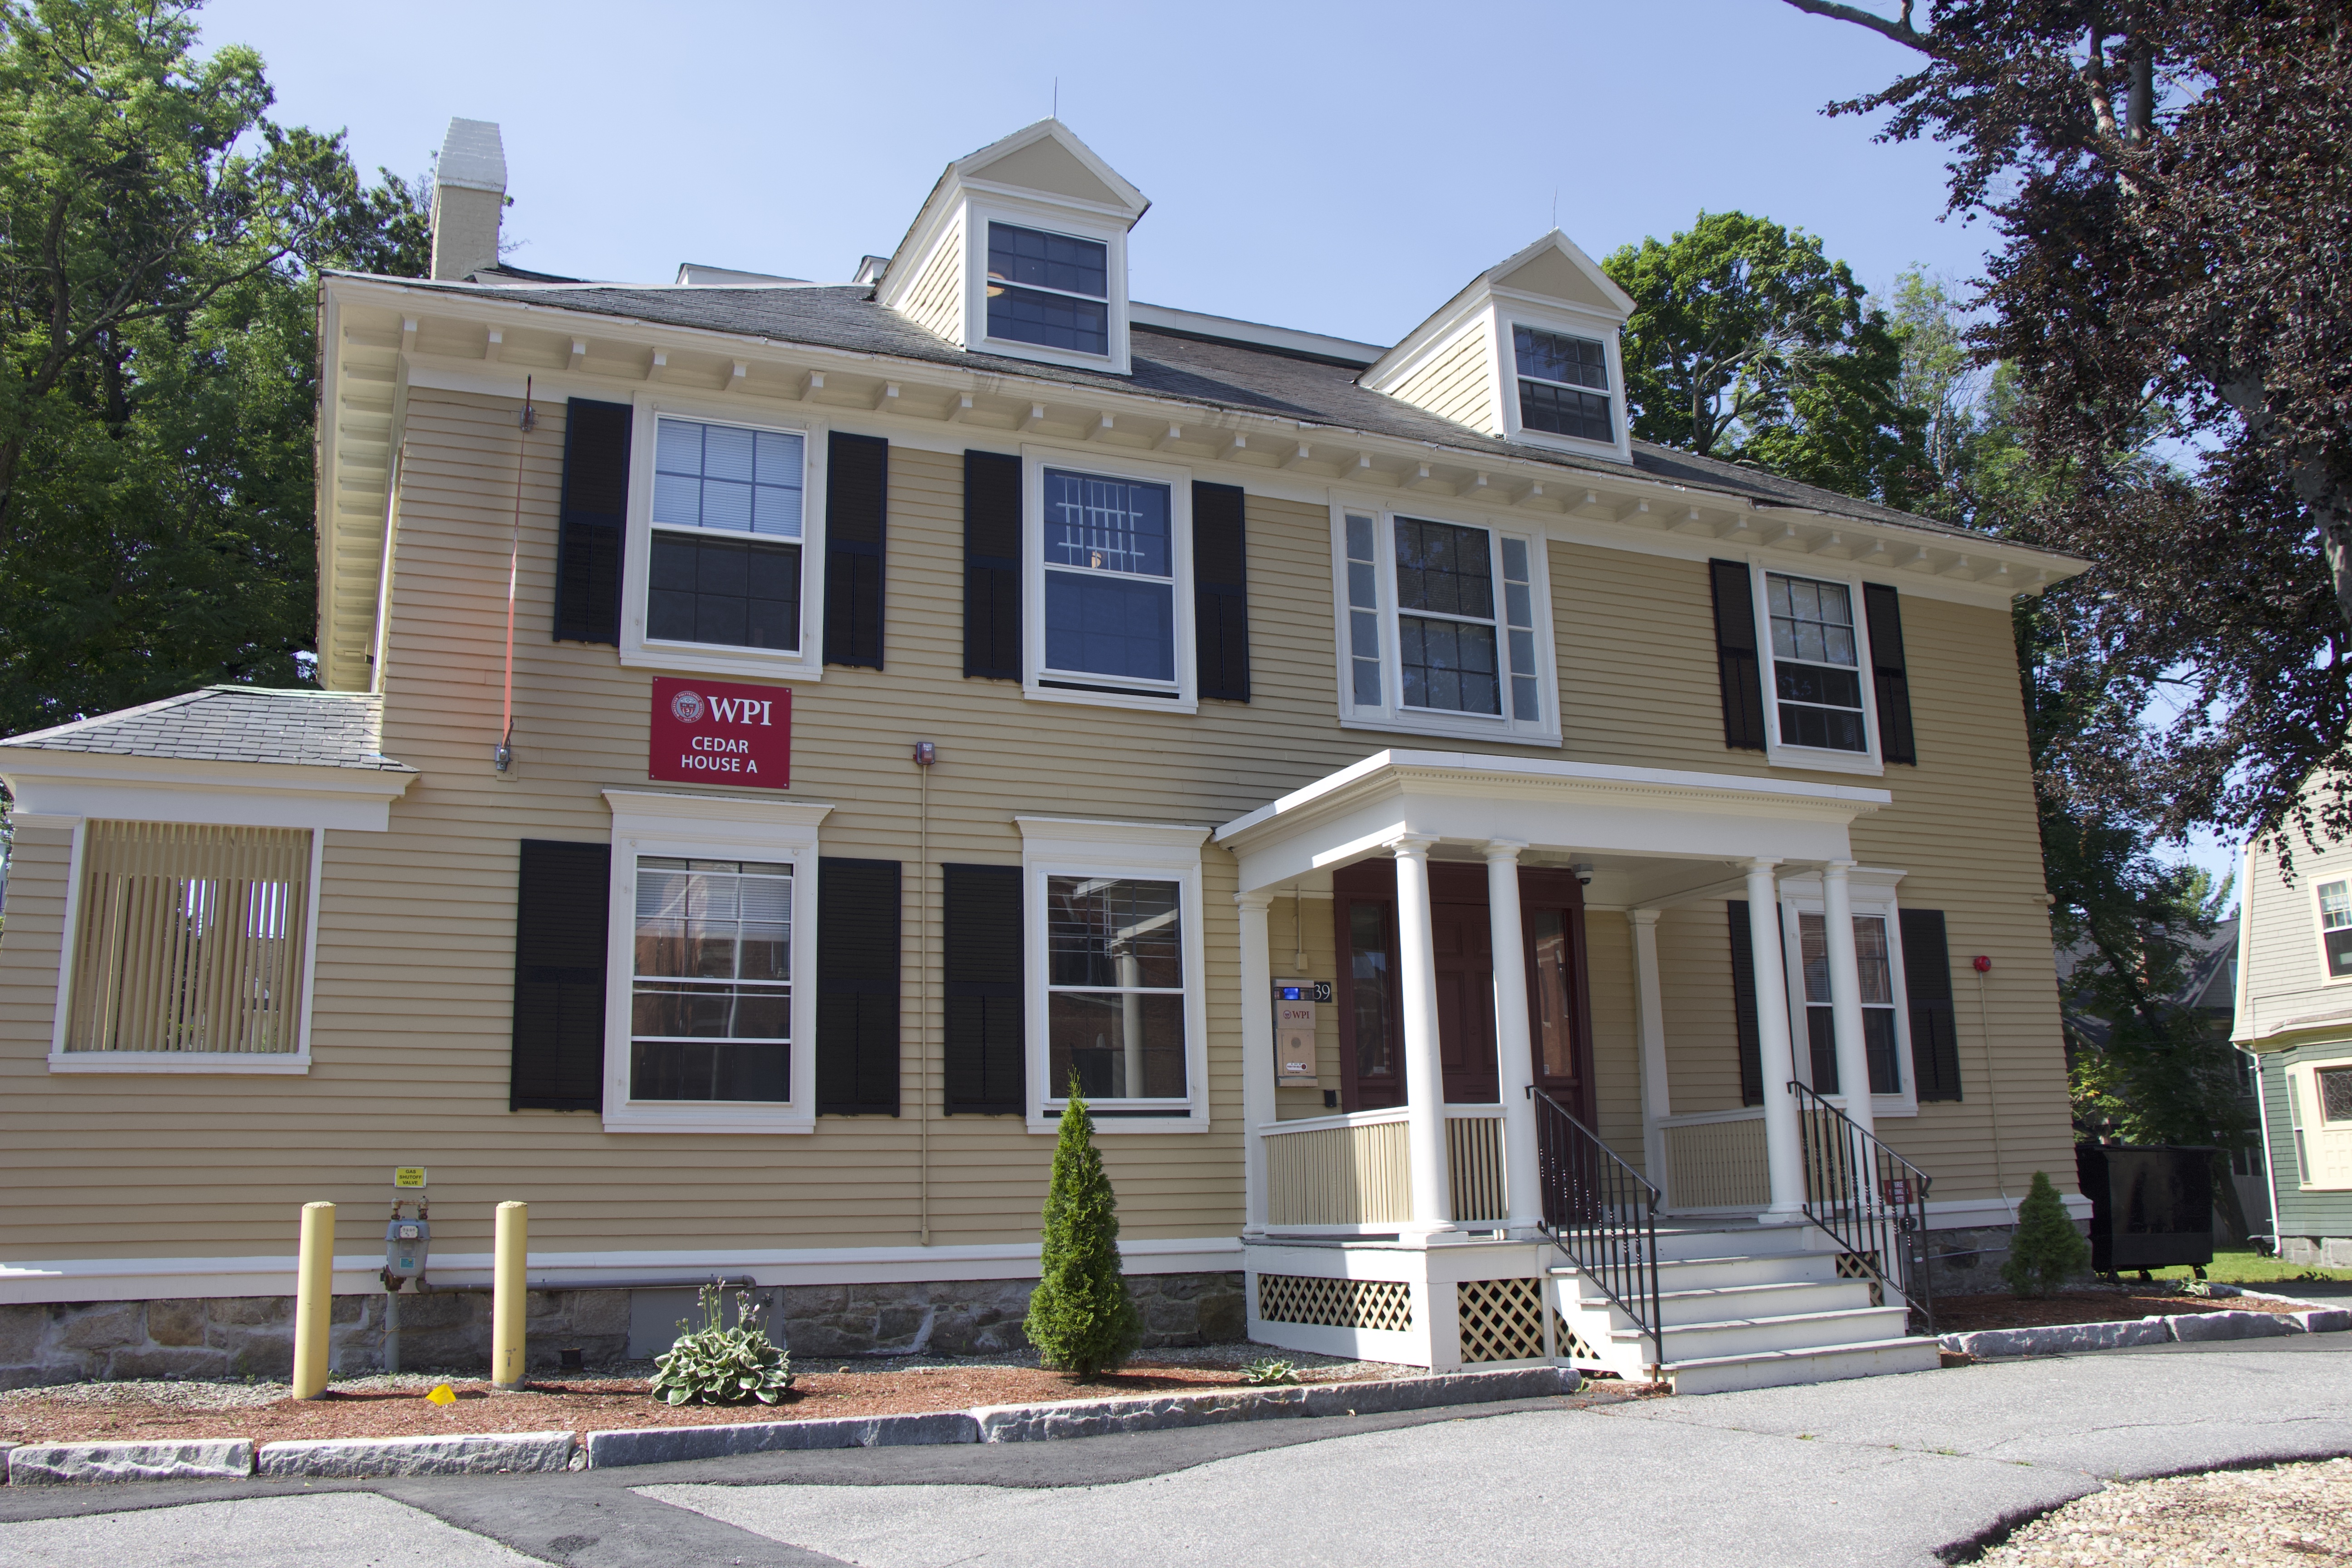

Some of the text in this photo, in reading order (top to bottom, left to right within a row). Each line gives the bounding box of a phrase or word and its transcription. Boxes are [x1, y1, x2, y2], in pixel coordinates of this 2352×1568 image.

[678, 692, 701, 701] POLYTECHNIC
[706, 696, 772, 726] WPI
[692, 736, 749, 754] CEDAR
[681, 754, 758, 773] HOUSE A
[1314, 984, 1331, 1000] 39
[1292, 1011, 1310, 1019] WPI
